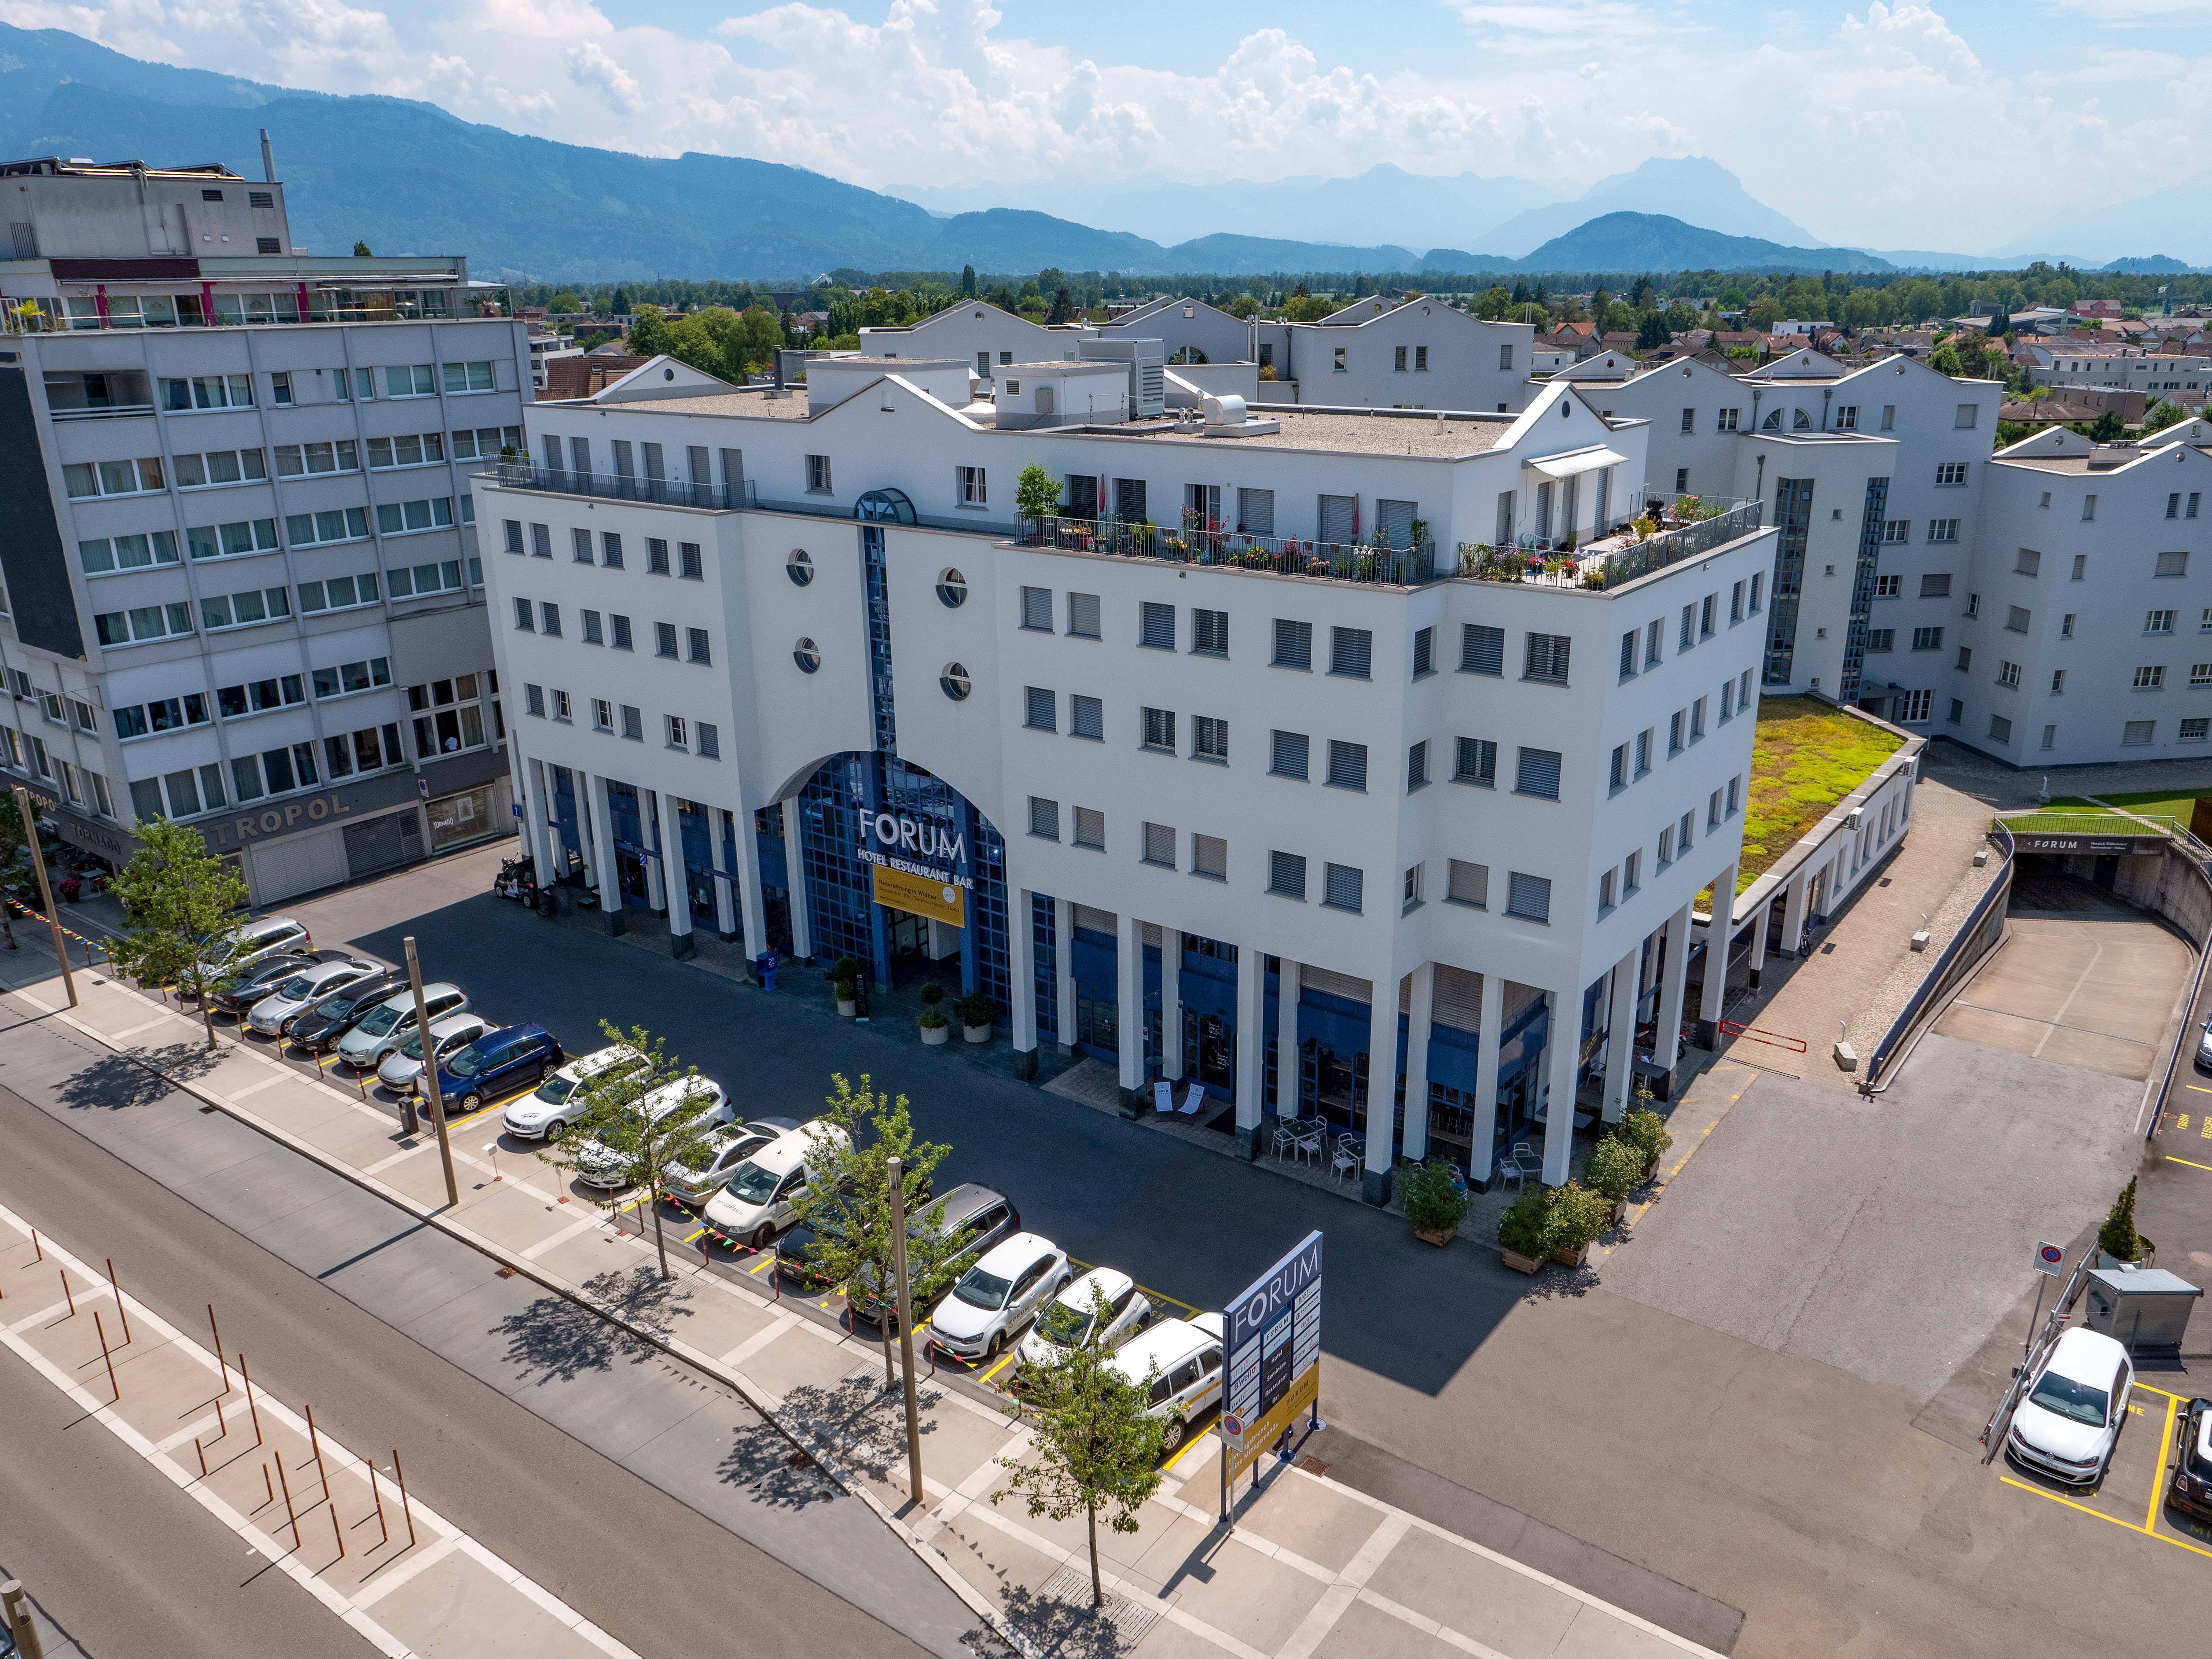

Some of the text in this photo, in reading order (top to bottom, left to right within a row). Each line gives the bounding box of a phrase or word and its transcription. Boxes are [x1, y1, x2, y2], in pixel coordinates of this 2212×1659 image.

[433, 817, 453, 830] TORNADO
[71, 823, 121, 855] TORNADO
[860, 808, 966, 863] FORUM
[858, 848, 974, 889] HOTEL RESTAURANT BAR
[878, 879, 911, 894] Neueröffnung
[919, 890, 937, 900] Widnau
[769, 957, 775, 966] 20
[2177, 1113, 2190, 1130] FORUM
[1235, 1244, 1318, 1343] FORUM
[1299, 1288, 1311, 1302] BARTL
[1301, 1295, 1319, 1313] ECKANKAR
[1009, 1306, 1029, 1324] FORUM
[1267, 1317, 1288, 1341] FORUM
[1271, 1350, 1282, 1364] Hotel
[1235, 1369, 1251, 1391] B.Well
[1267, 1361, 1286, 1381] Seminare
[1265, 1373, 1287, 1397] Restaurant
[1286, 1380, 1308, 1405] FORUM
[1244, 1422, 1278, 1460] Mittagsmenüs
